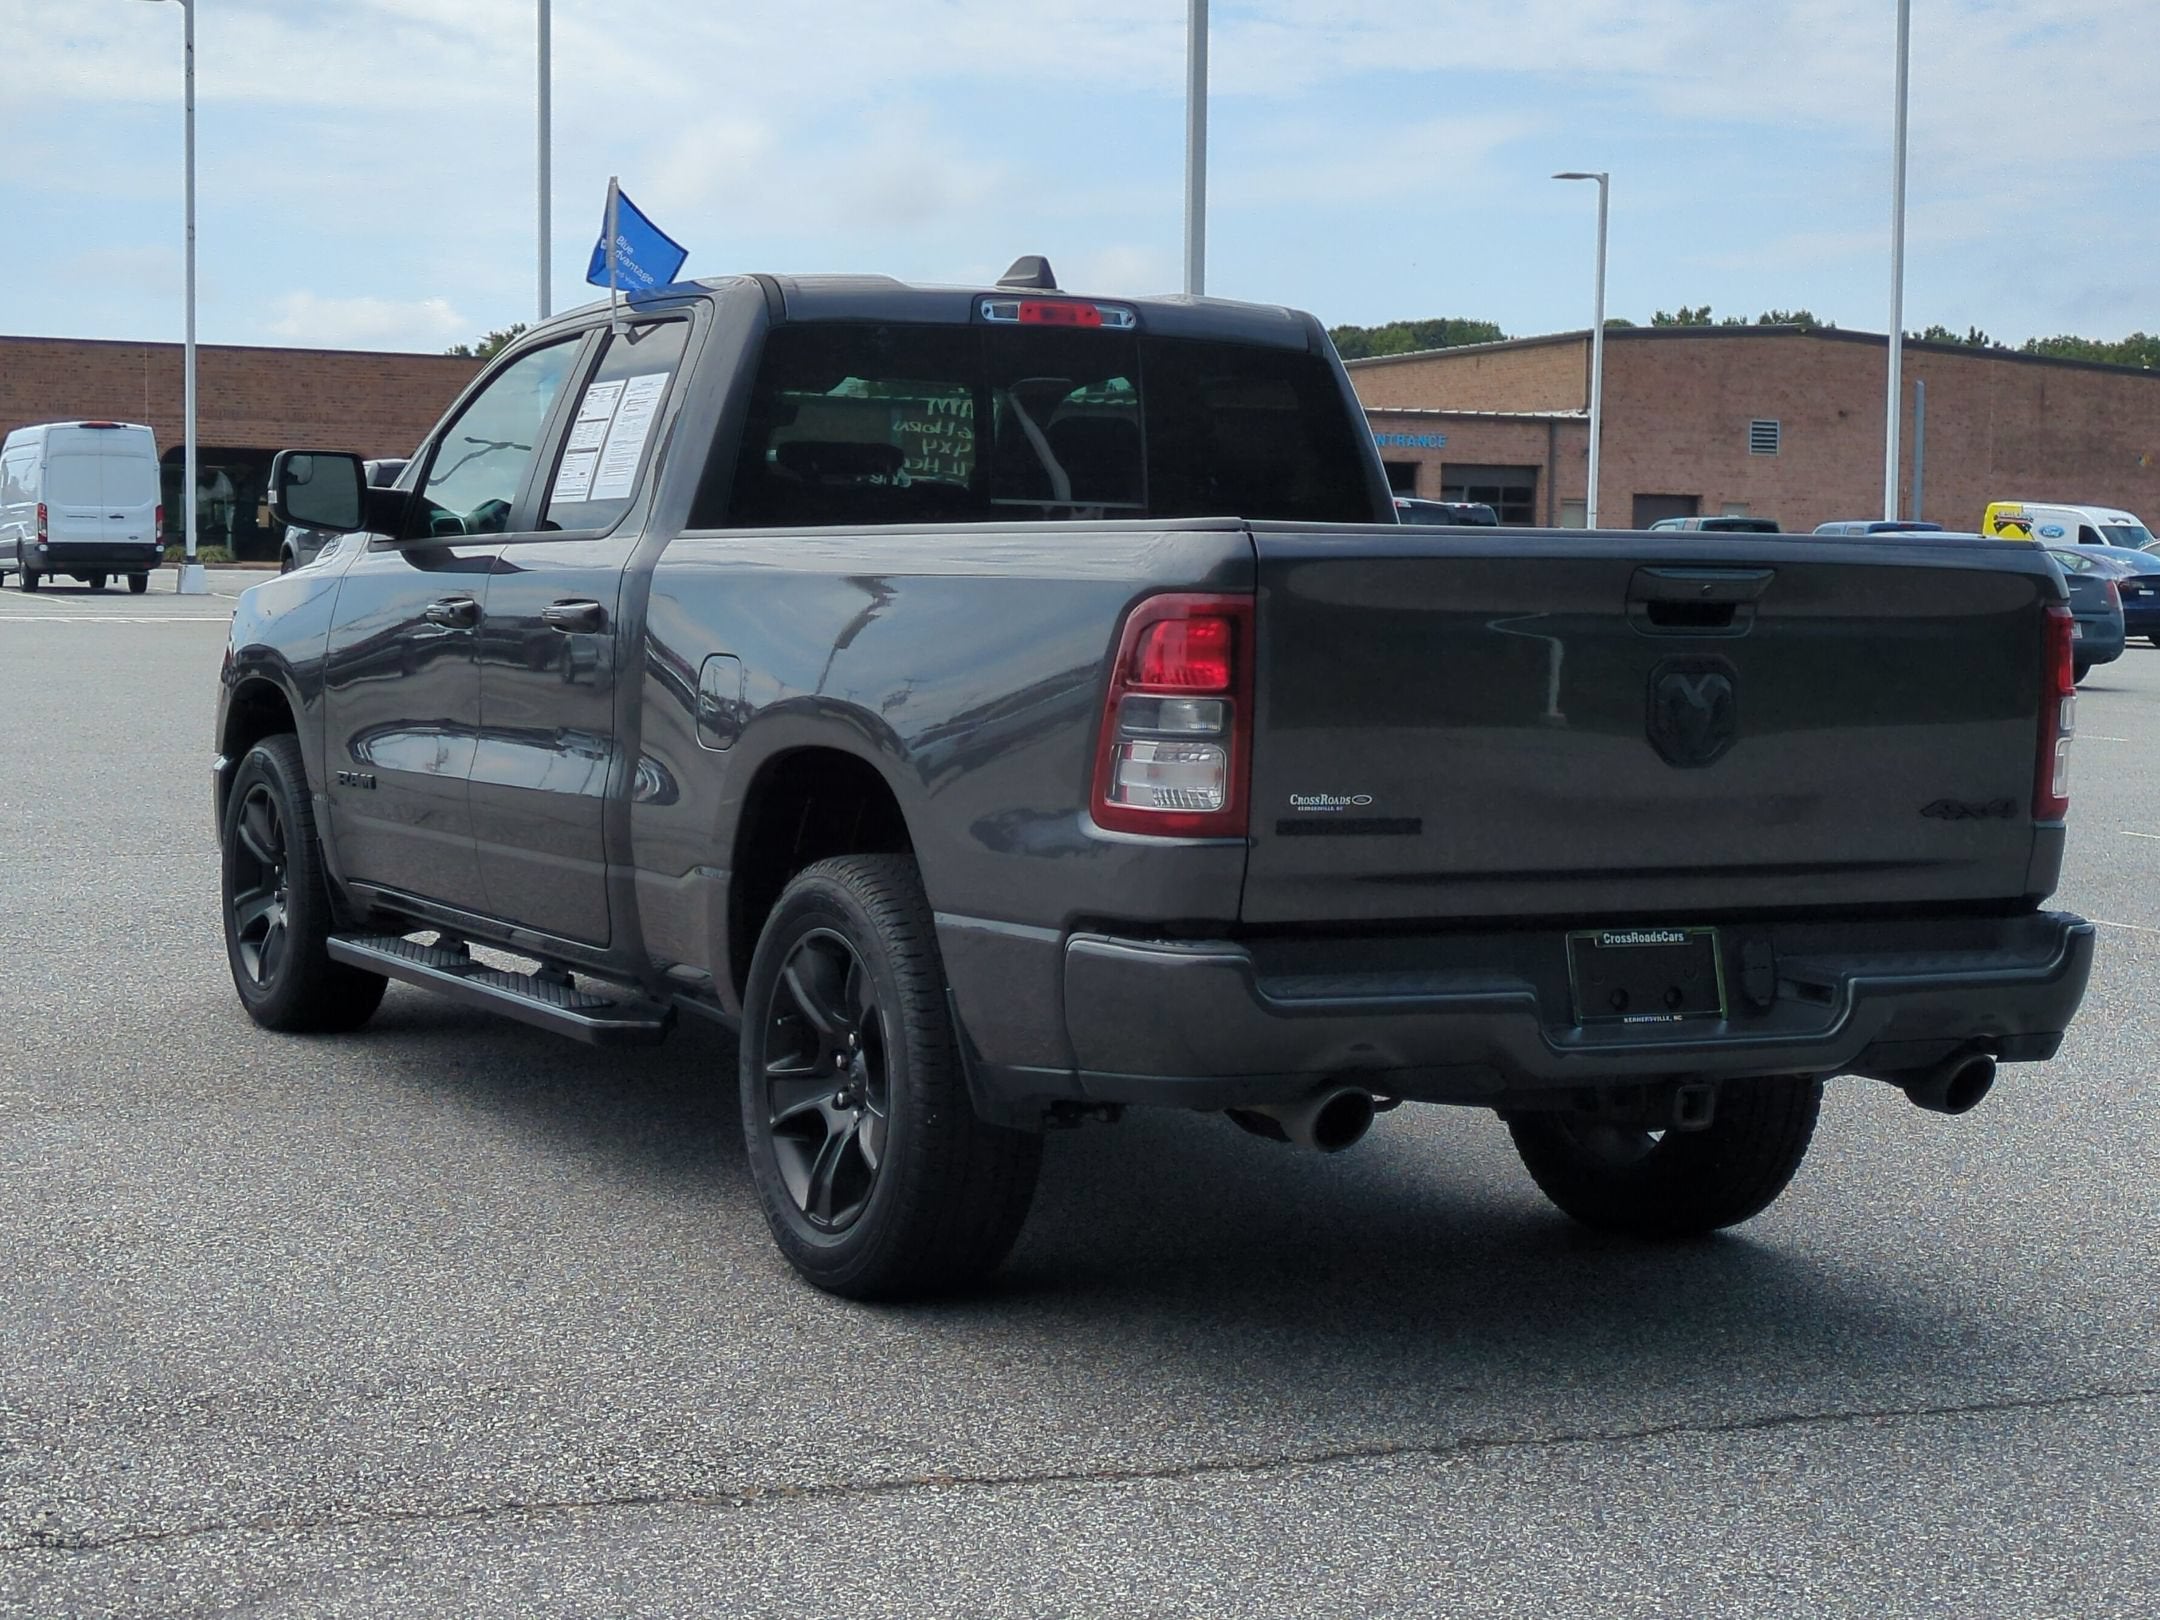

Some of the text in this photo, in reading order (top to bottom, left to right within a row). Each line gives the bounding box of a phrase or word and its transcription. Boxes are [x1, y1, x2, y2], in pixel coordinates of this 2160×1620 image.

[616, 235, 634, 255] Blue
[616, 250, 655, 285] dvantage
[1374, 432, 1448, 449] NTRANCE
[1603, 931, 1685, 944] CrossRoadsCars
